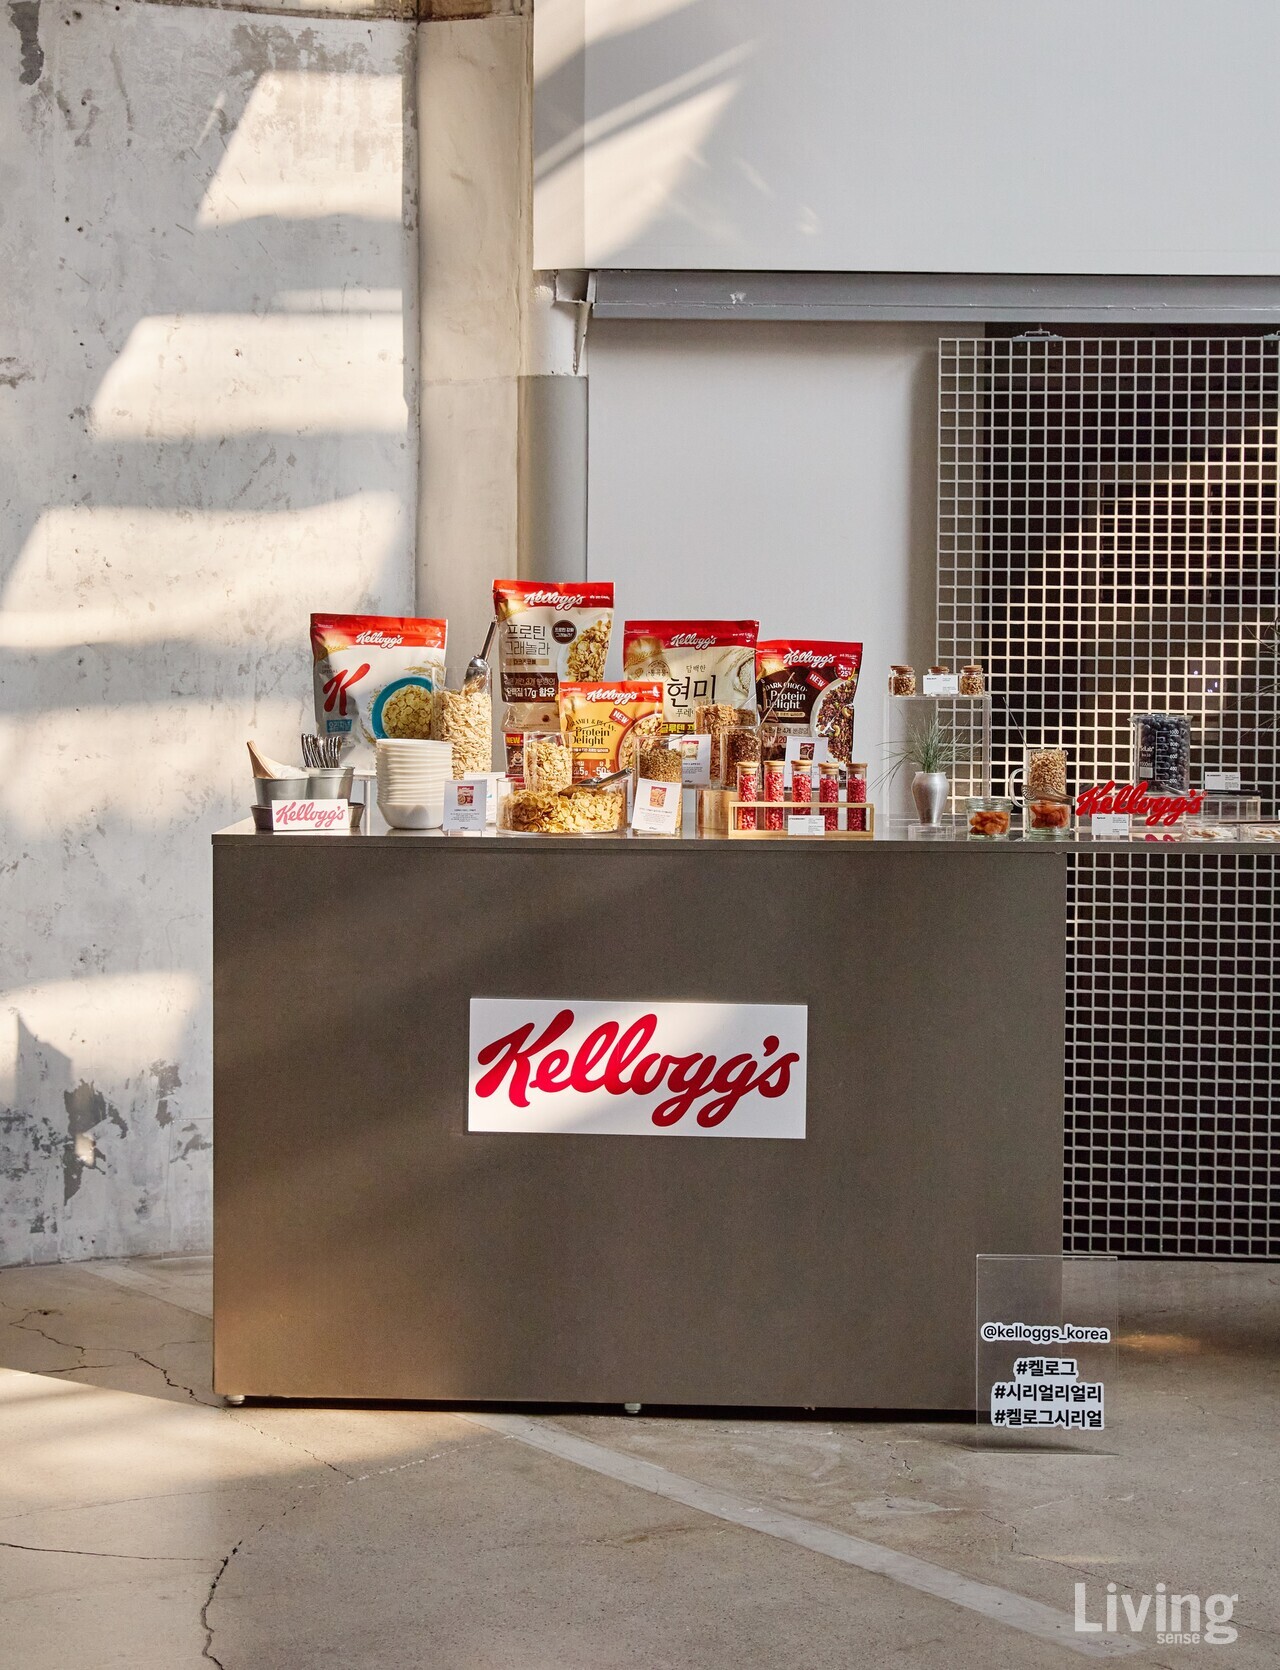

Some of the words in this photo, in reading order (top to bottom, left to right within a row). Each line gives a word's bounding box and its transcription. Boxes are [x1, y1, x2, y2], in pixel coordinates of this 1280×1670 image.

[524, 590, 585, 611] Kellogg's
[355, 630, 404, 649] Kellogg's
[507, 624, 545, 640] 프로틴
[506, 641, 550, 656] 그래놀라
[670, 633, 717, 651] Kellogg's
[783, 650, 837, 668] Kellogg's
[686, 664, 706, 674] 담백한
[765, 682, 783, 692] DARK
[783, 682, 806, 692] CHOCO
[809, 673, 826, 688] NEW
[322, 663, 371, 717] K
[524, 687, 537, 699] 17g
[586, 688, 639, 705] Kellogg's
[667, 674, 717, 708] 현미
[770, 689, 806, 701] Protein
[765, 698, 801, 711] Delight
[612, 710, 629, 724] NEW
[506, 736, 521, 745] NEW
[575, 726, 610, 737] Protein
[1075, 780, 1208, 827] Kellogg's
[275, 801, 346, 828] Kellogg's
[474, 1008, 801, 1129] Kellogg's
[982, 1324, 1109, 1342] @kelloggs_korea
[1015, 1358, 1077, 1377] #켈로그
[993, 1383, 1102, 1403] #시리얼리얼리
[993, 1408, 1102, 1428] #켈로그시리얼
